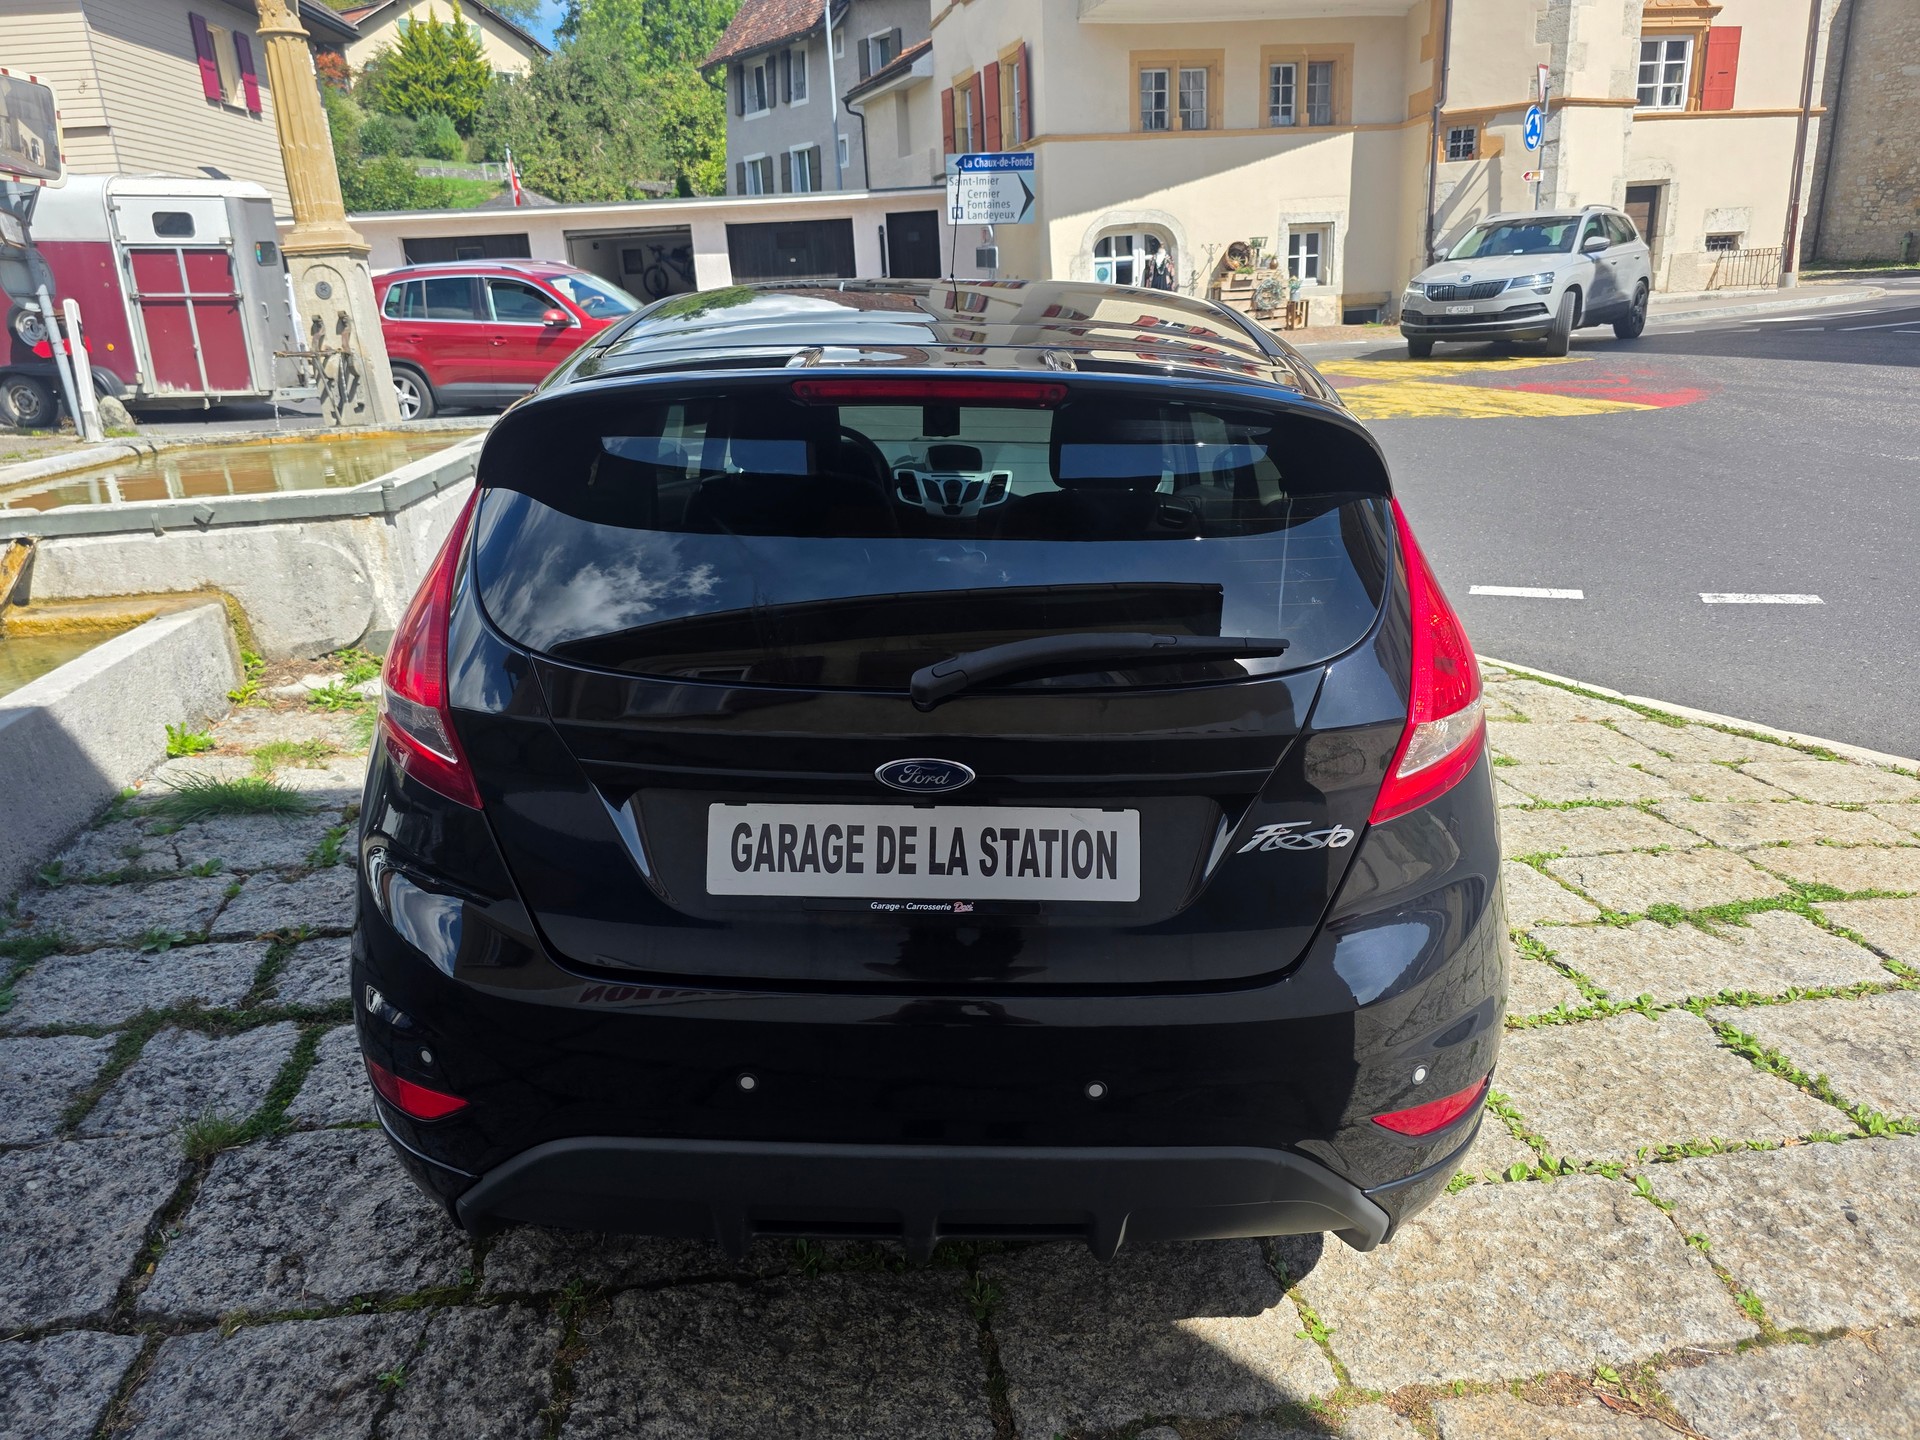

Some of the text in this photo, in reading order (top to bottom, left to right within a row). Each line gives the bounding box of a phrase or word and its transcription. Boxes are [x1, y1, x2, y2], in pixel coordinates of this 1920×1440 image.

[963, 157, 1033, 168] La Chaux-de-Fonds
[967, 189, 1001, 198] Cernier
[967, 200, 1011, 209] Fontaines
[967, 211, 1016, 221] Landeyeux
[898, 764, 951, 785] Ford
[1236, 821, 1355, 854] Fiesta
[731, 823, 1118, 880] GARAGE DE LA STATION
[870, 902, 900, 912] Garage
[906, 902, 952, 910] Carrosserie
